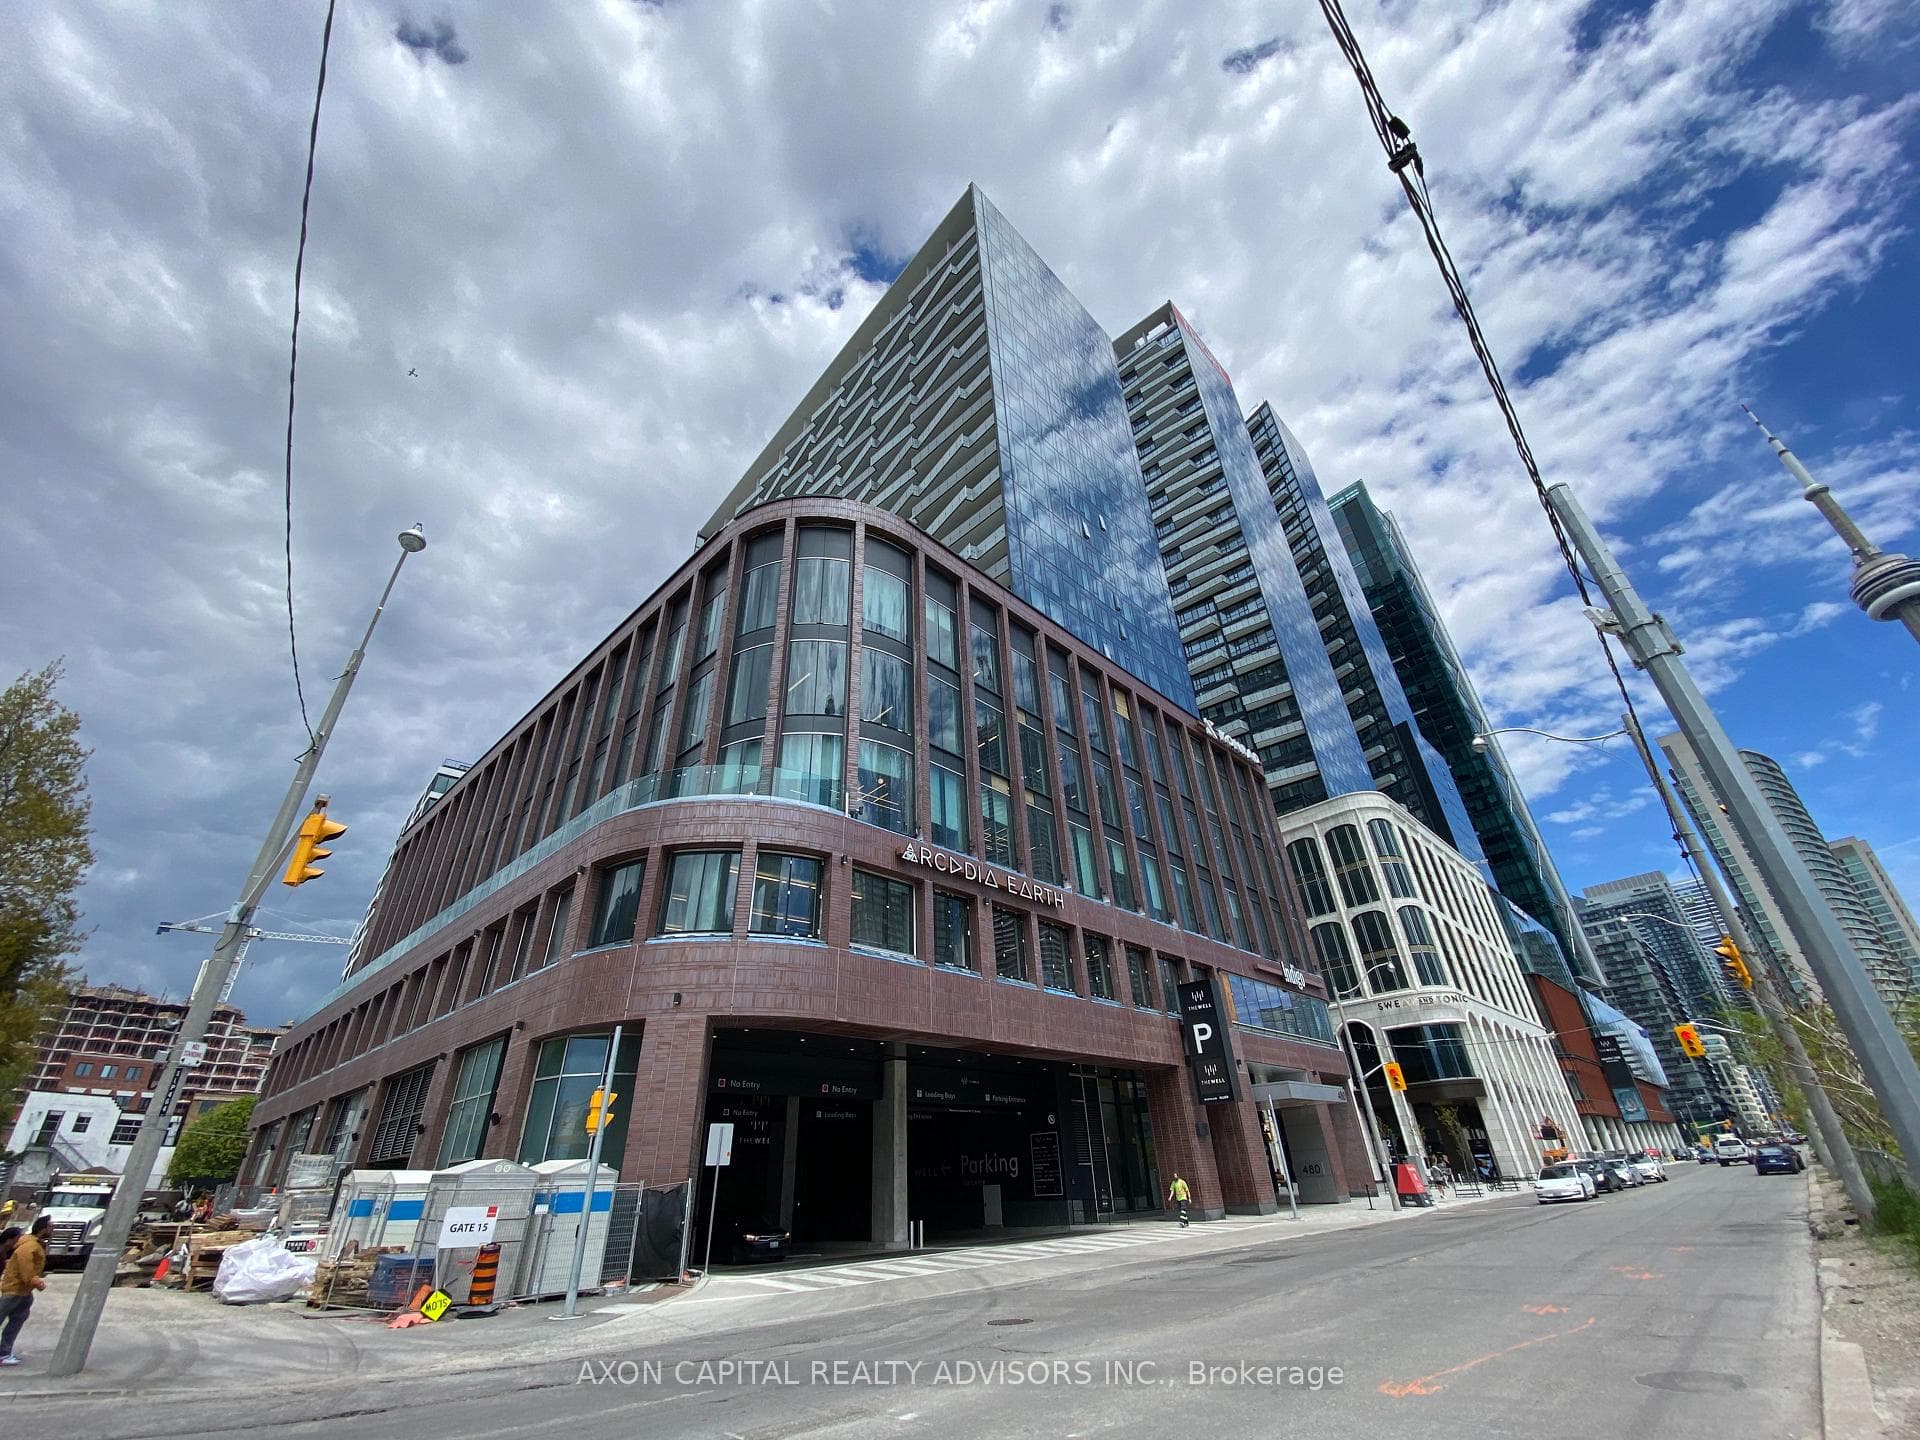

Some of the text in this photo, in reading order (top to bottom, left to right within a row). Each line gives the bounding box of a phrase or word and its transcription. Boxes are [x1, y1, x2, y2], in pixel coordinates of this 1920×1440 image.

[902, 843, 1065, 910] ARCADIA EARTH
[1193, 1023, 1212, 1054] P
[730, 1080, 761, 1090] No Entry
[841, 1086, 857, 1095] Entry
[961, 1153, 1018, 1178] Parking
[1303, 1164, 1320, 1174] 480
[450, 1222, 488, 1233] GATE 15
[425, 1299, 448, 1312] SLOW
